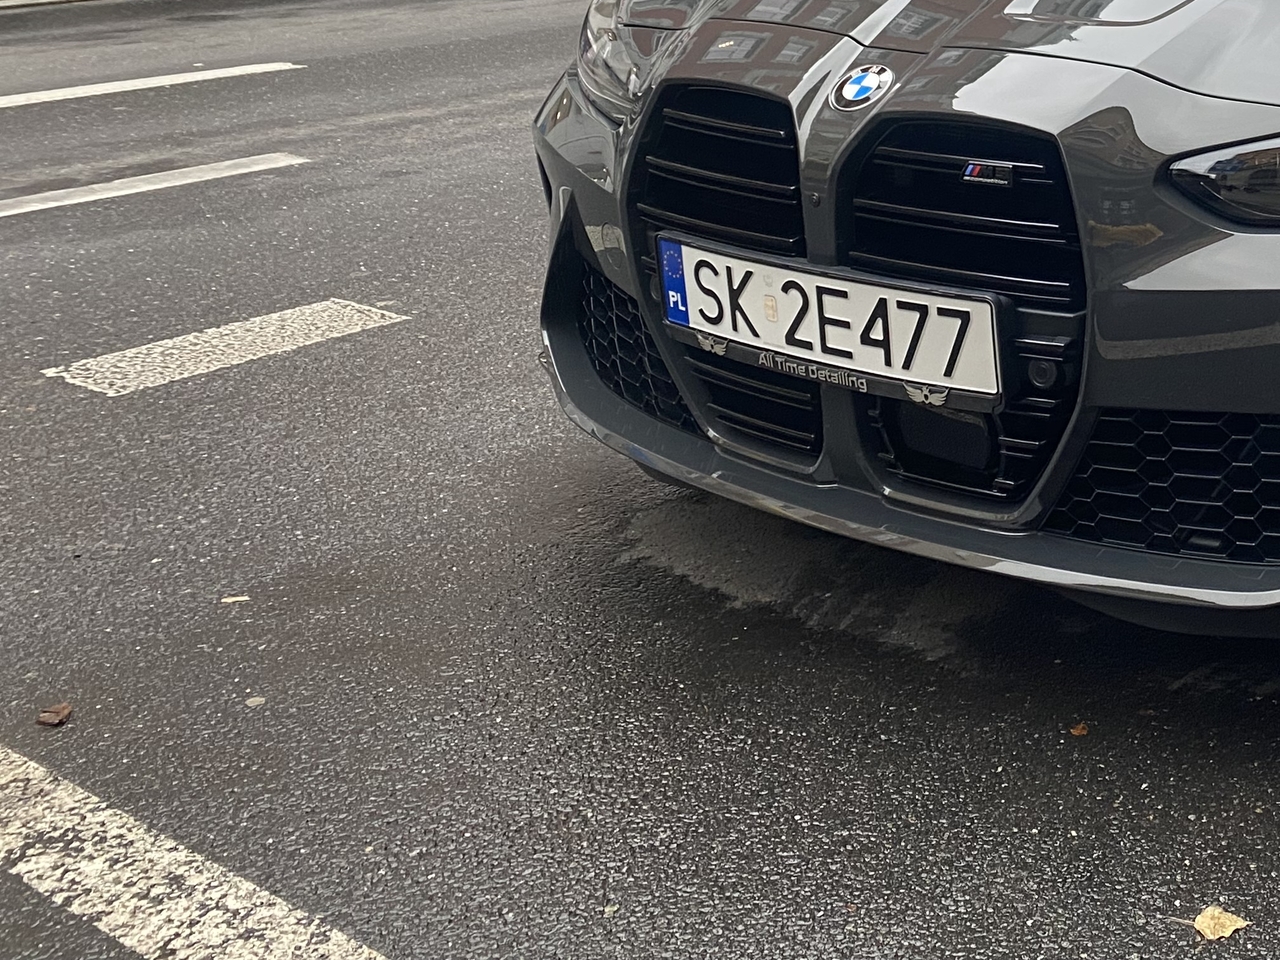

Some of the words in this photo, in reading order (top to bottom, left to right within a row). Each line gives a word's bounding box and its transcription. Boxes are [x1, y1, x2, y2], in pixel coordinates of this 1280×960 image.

[668, 290, 686, 312] PL
[693, 258, 760, 338] SK
[780, 279, 972, 379] 2E477
[758, 352, 773, 369] All
[775, 356, 806, 376] Time
[808, 364, 868, 394] Detailing
